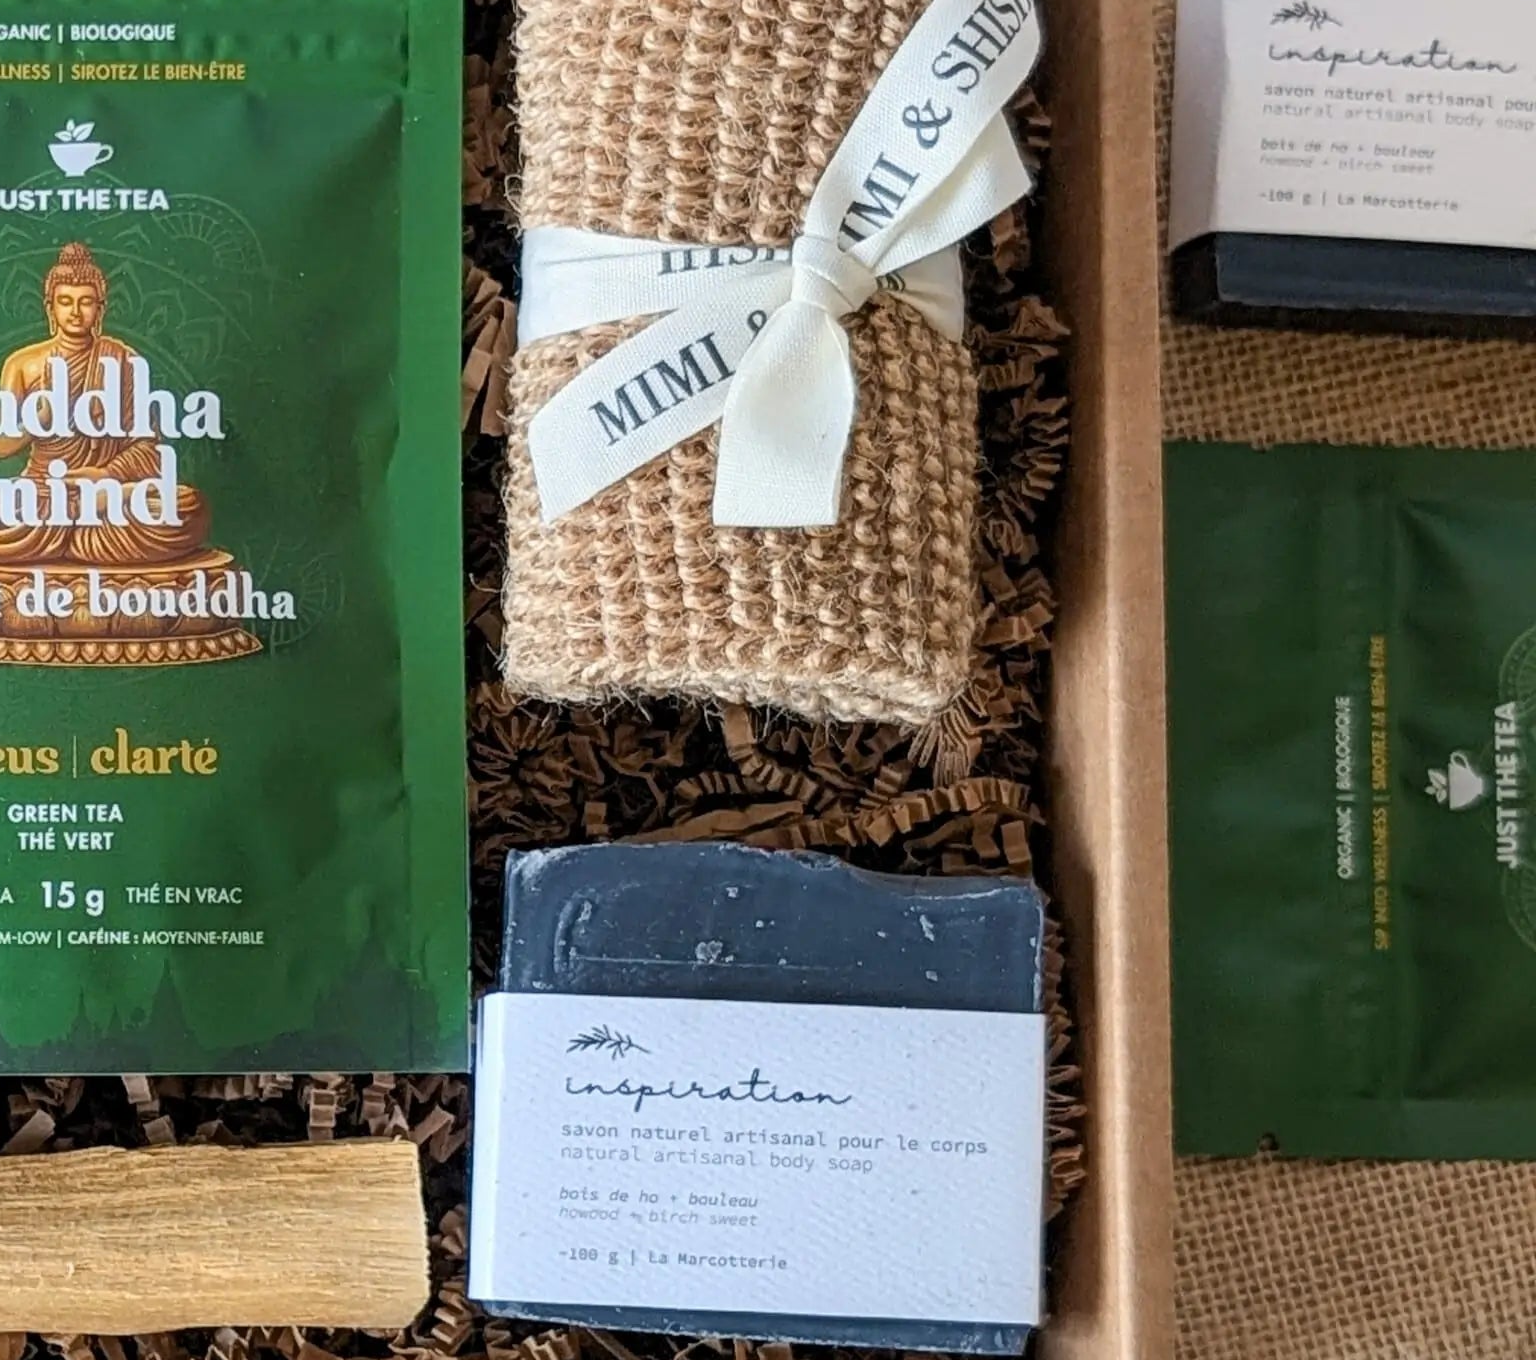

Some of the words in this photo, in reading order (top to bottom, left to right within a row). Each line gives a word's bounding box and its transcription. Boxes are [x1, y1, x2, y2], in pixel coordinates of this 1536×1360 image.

[71, 24, 175, 42] BIOLOGIQUE
[71, 64, 138, 80] SIROTEZ
[144, 64, 159, 80] LE
[165, 60, 246, 80] BIEN-ÊTRE
[1268, 39, 1517, 77] inspiration
[1264, 84, 1314, 97] savon
[1324, 85, 1395, 102] naturel
[1405, 91, 1494, 110] artisanal
[839, 153, 920, 252] IMI
[902, 98, 954, 150] &
[57, 189, 110, 210] THE
[115, 189, 169, 211] TEA
[588, 331, 737, 447] MIMI
[15, 571, 74, 621] de
[89, 570, 297, 621] bouddha
[1494, 701, 1516, 752] TEA
[91, 727, 217, 775] clarté
[1495, 753, 1519, 802] THE
[7, 804, 77, 824] GREEN
[85, 804, 124, 824] TEA
[18, 828, 55, 851] THÉ
[64, 831, 113, 851] VERT
[1496, 809, 1520, 869] JUST
[40, 880, 75, 909] 15
[85, 886, 104, 917] g
[125, 884, 160, 904] THÉ
[165, 887, 190, 904] EN
[194, 887, 242, 905] VRAC
[67, 927, 130, 945] CAFÉINE
[143, 930, 265, 945] MOYENNE-FAIBLE
[565, 1067, 852, 1111] inspiration
[561, 1122, 618, 1141] savon
[631, 1125, 710, 1143] naturel
[723, 1126, 826, 1148] artisanal
[838, 1134, 884, 1153] pour
[899, 1133, 919, 1150] le
[930, 1139, 987, 1155] corps
[560, 1144, 641, 1163] natural
[653, 1148, 758, 1166] artisanal
[770, 1151, 815, 1172] body
[828, 1156, 874, 1174] soap
[648, 1250, 669, 1265] La
[678, 1252, 788, 1270] Marcotterie
